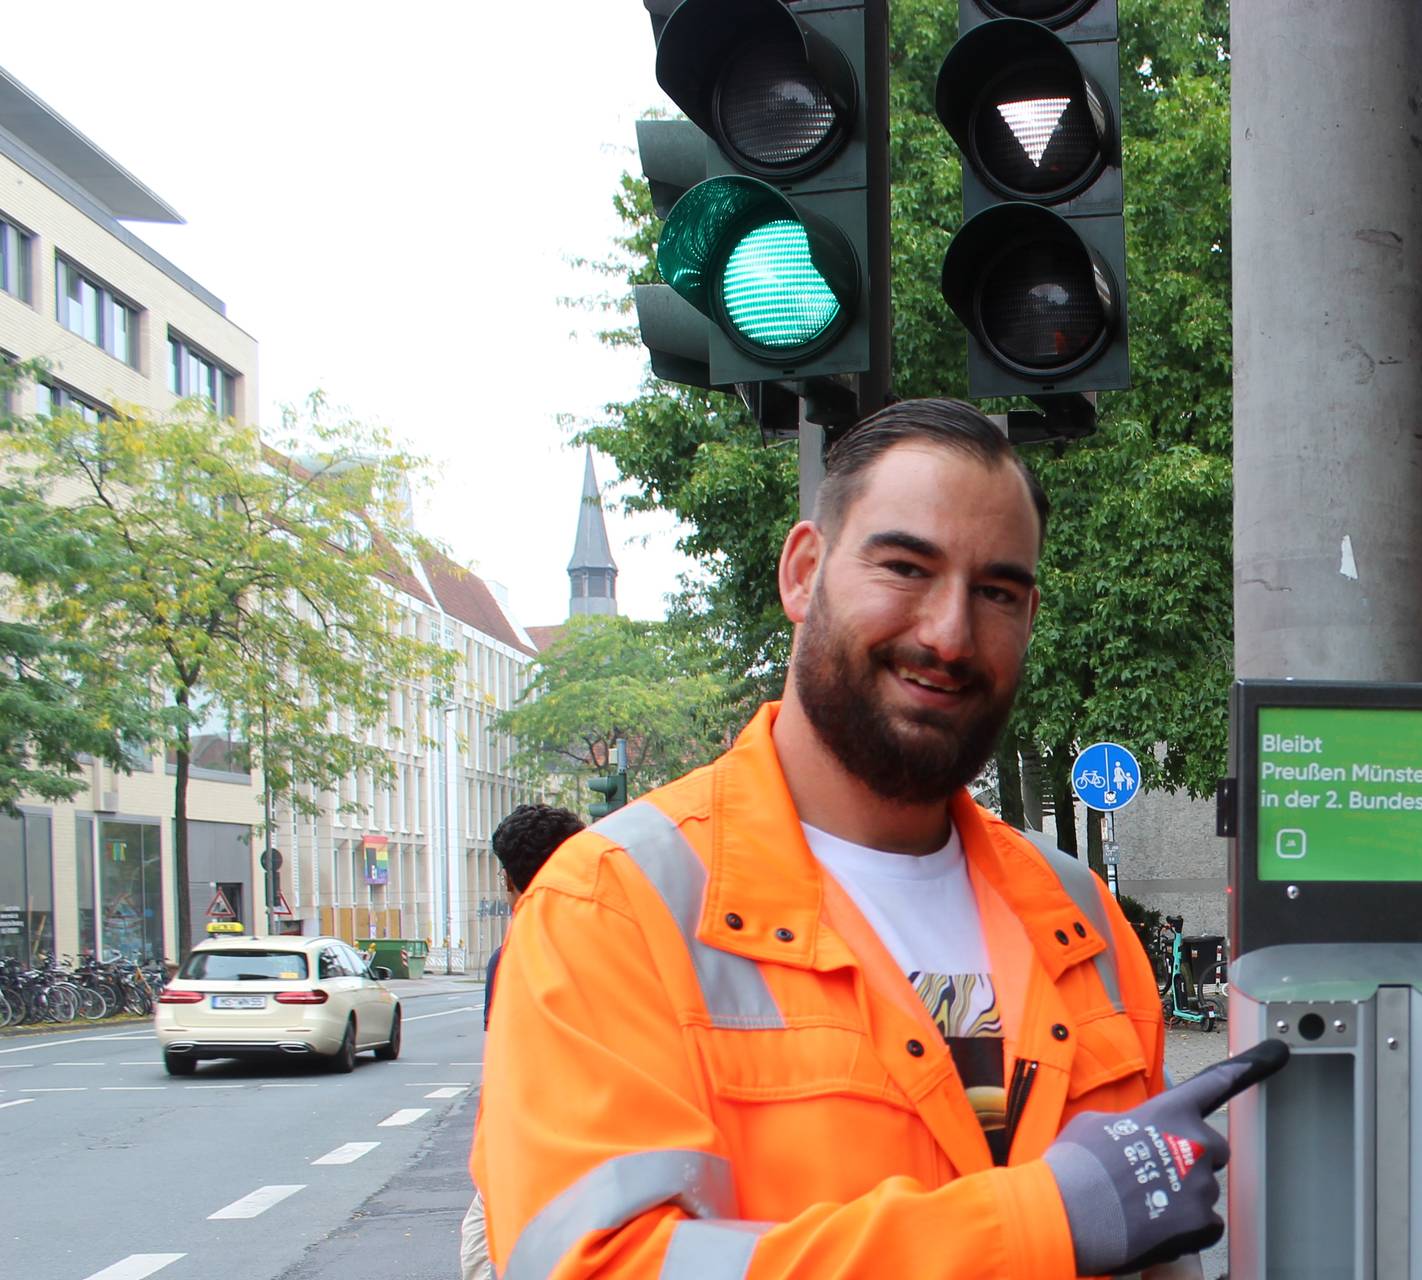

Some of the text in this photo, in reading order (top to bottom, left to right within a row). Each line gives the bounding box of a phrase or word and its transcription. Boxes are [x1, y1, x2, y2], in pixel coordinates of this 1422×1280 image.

[1262, 734, 1323, 753] Bleibt
[1261, 762, 1347, 782] Preußen
[1260, 790, 1279, 808] in
[1284, 791, 1320, 809] der
[1325, 790, 1343, 809] 2.
[1144, 1125, 1172, 1167] PADUA
[1166, 1166, 1182, 1192] PRO
[1134, 1166, 1149, 1184] 10
